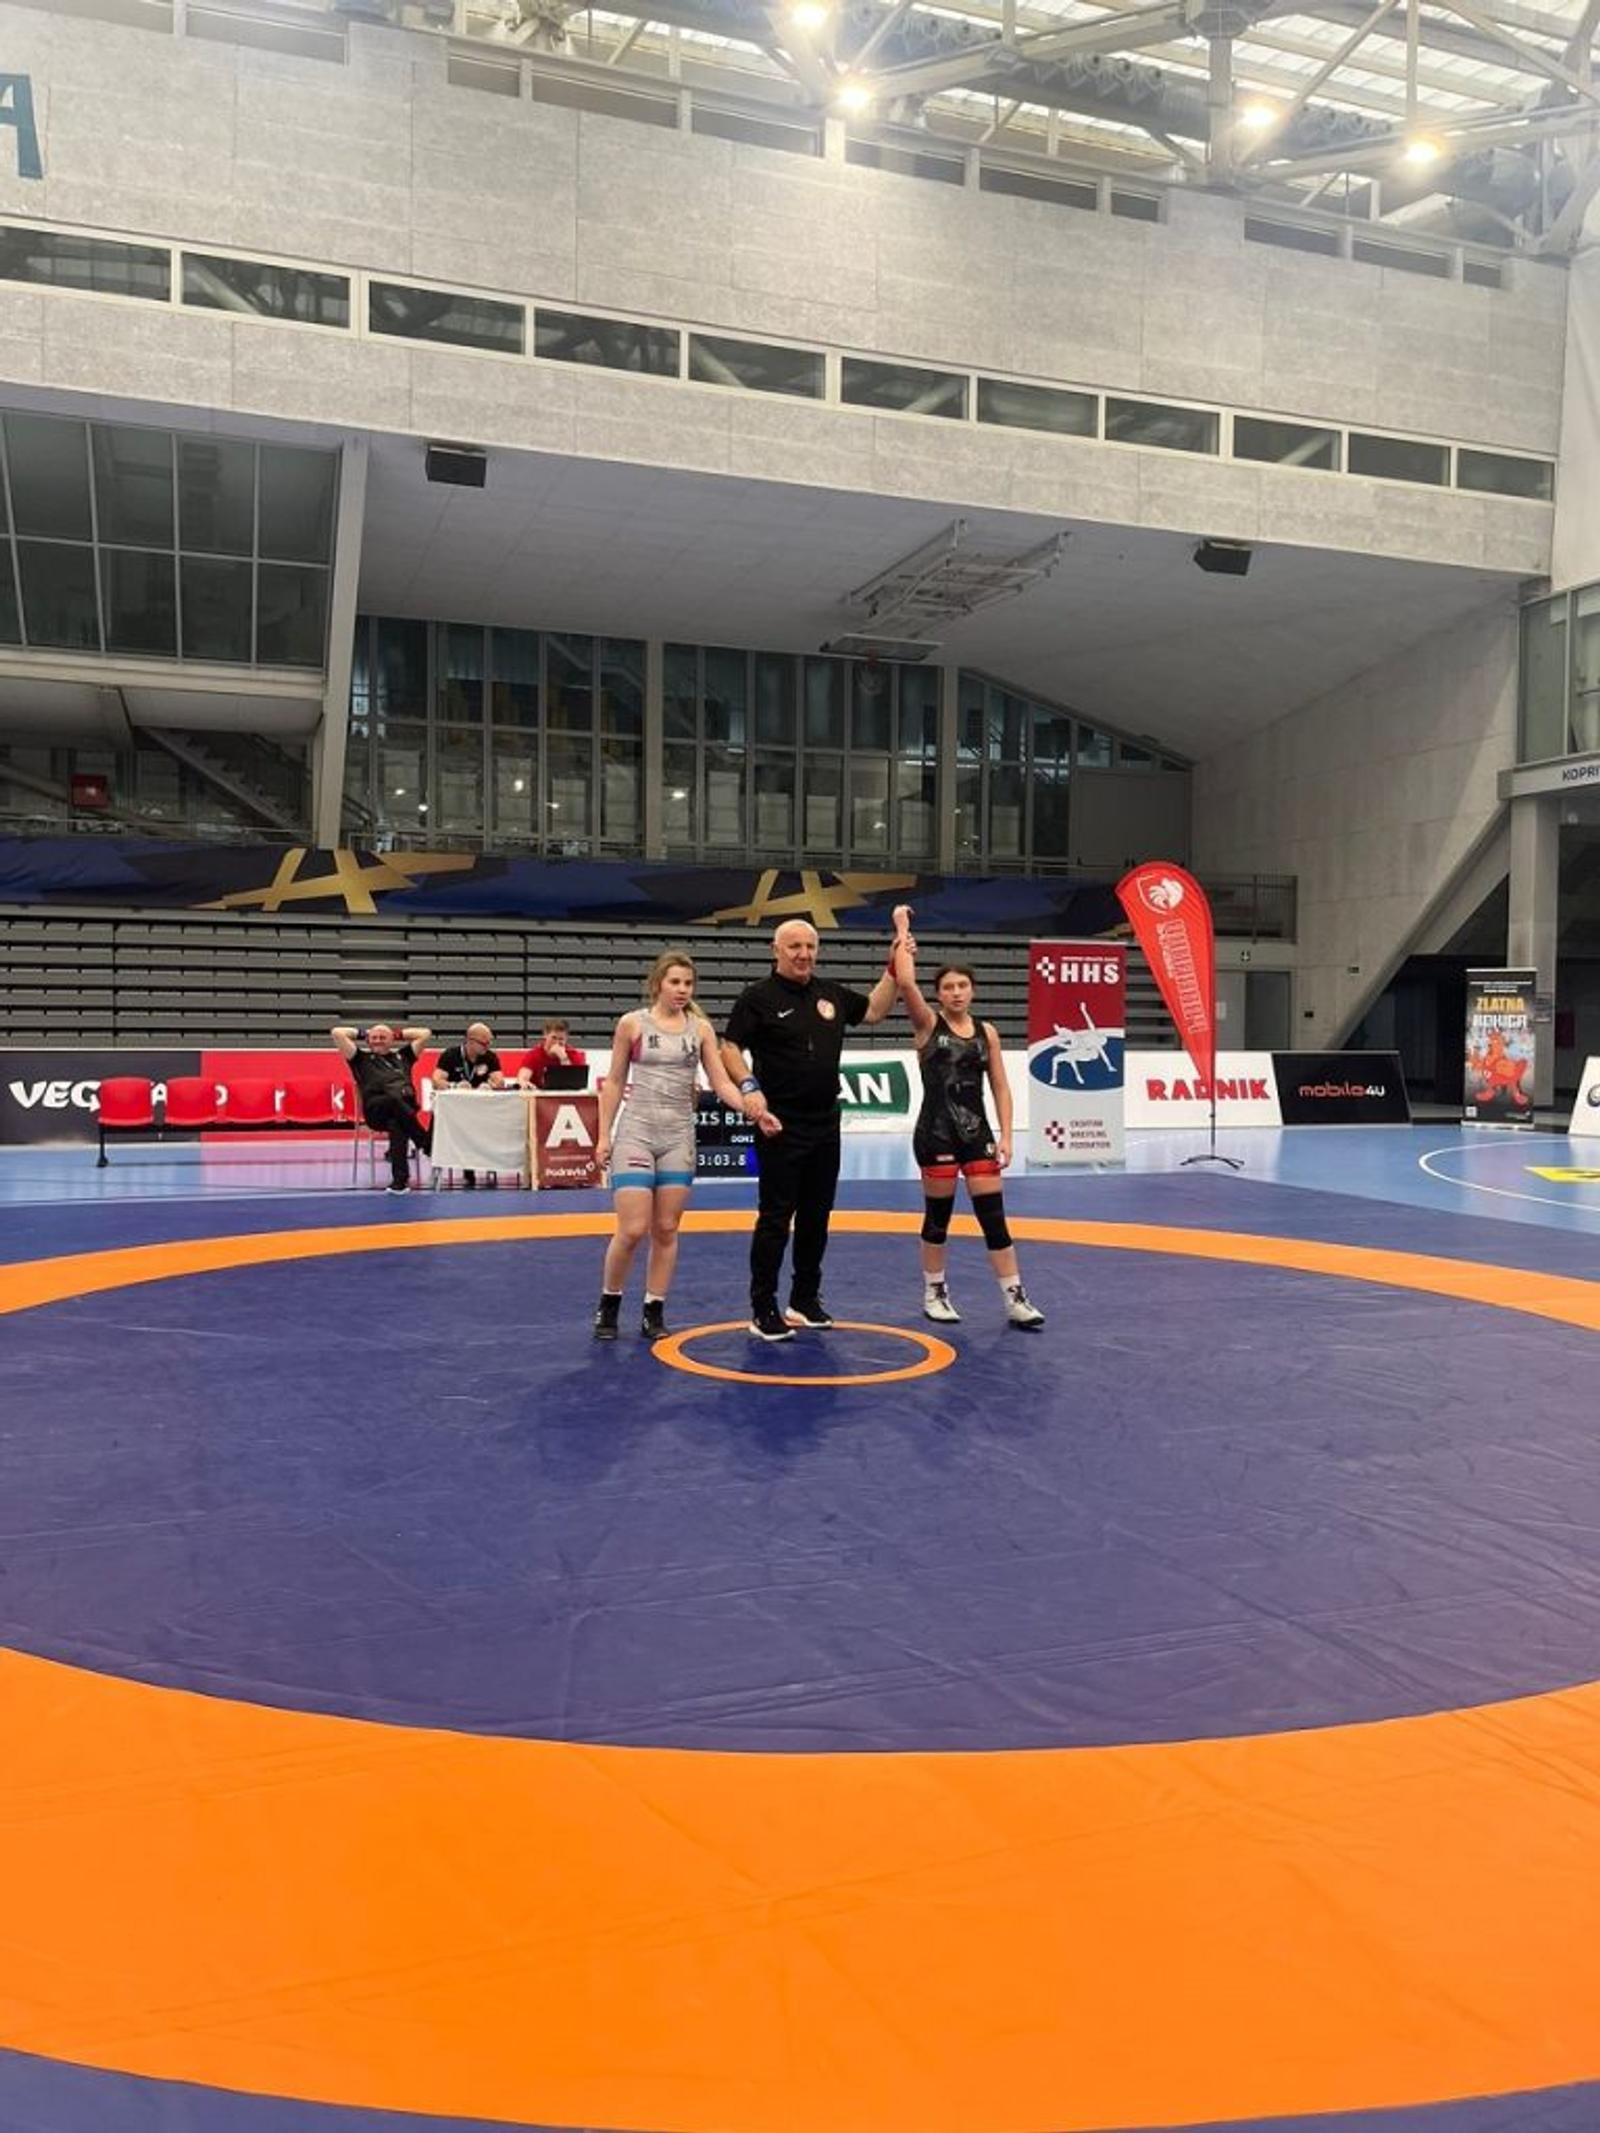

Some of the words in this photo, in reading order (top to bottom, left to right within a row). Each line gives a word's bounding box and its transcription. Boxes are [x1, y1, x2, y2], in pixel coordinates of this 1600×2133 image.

[1061, 962, 1119, 984] HHS
[1477, 997, 1524, 1012] ZLATNA
[1146, 1079, 1270, 1100] RADNIK
[545, 1104, 593, 1147] A
